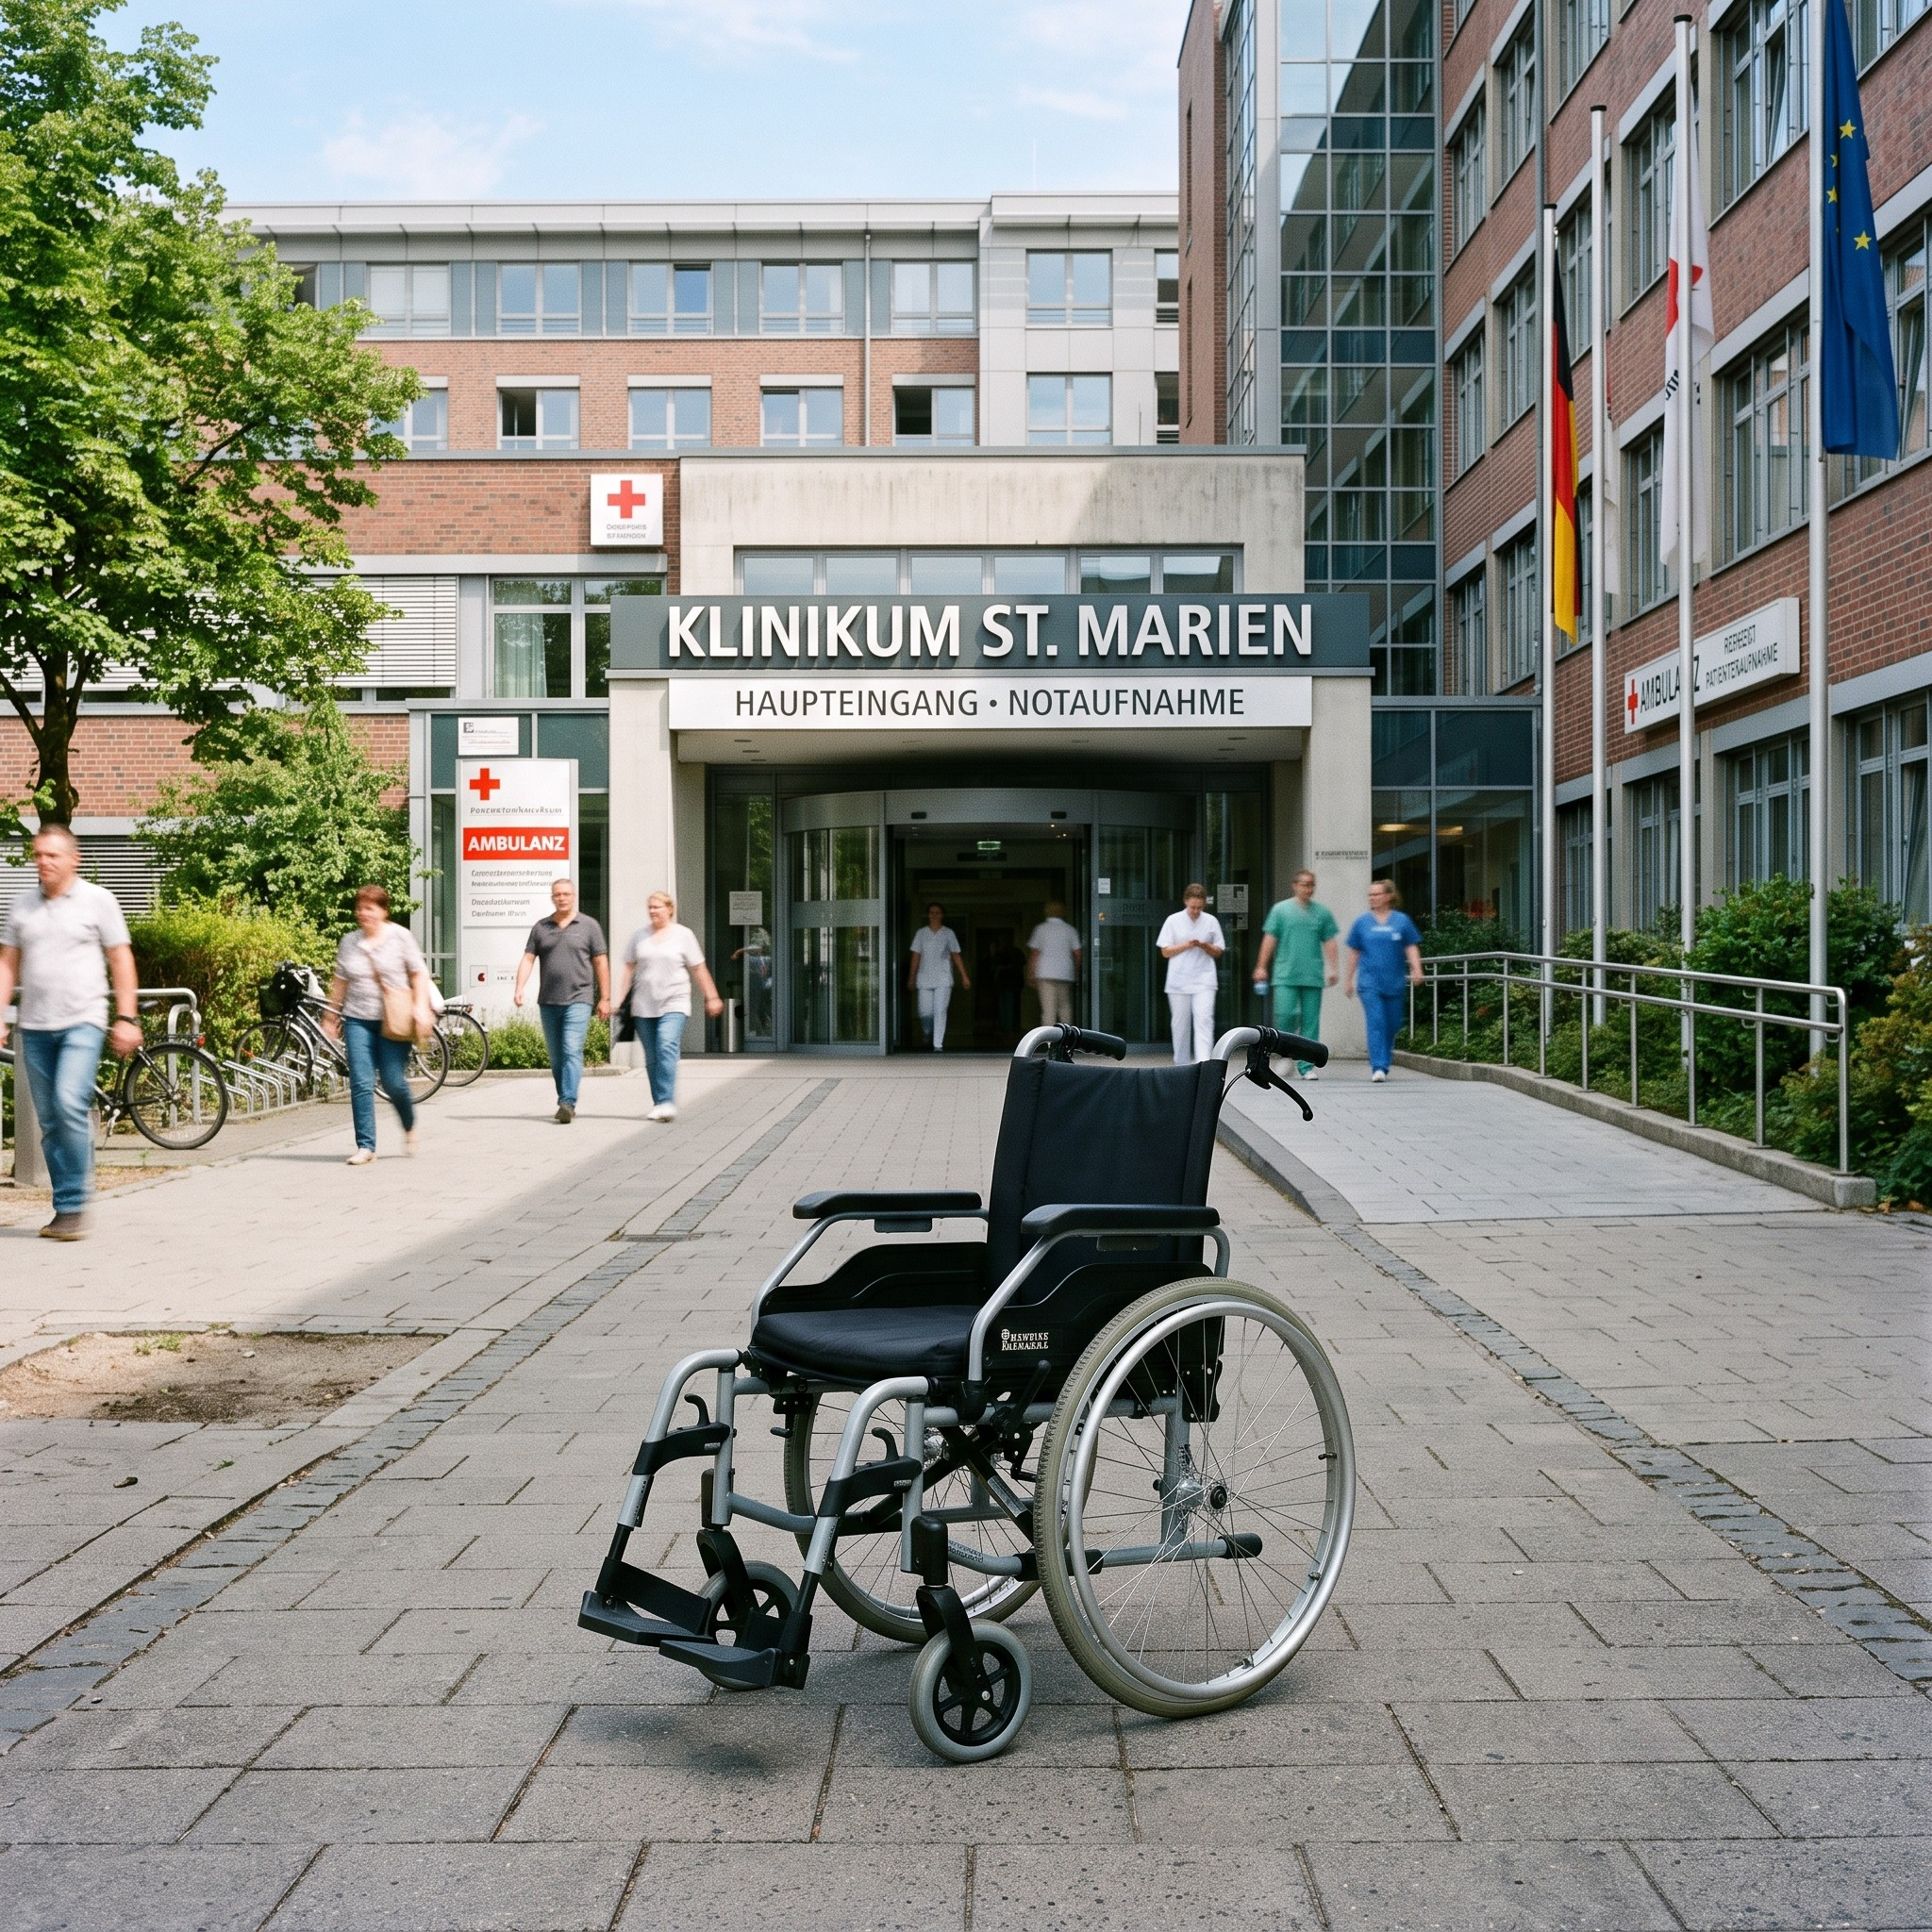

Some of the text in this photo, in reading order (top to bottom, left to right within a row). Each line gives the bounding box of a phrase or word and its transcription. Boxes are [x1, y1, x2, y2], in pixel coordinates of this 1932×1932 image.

[667, 604, 1312, 658] KLINIKUM ST. MARIEN
[735, 688, 1244, 718] HAUPTEINGANG NOTAUFNAHME
[1641, 655, 1700, 713] AMBULAZ
[468, 836, 565, 852] AMBULANZ
